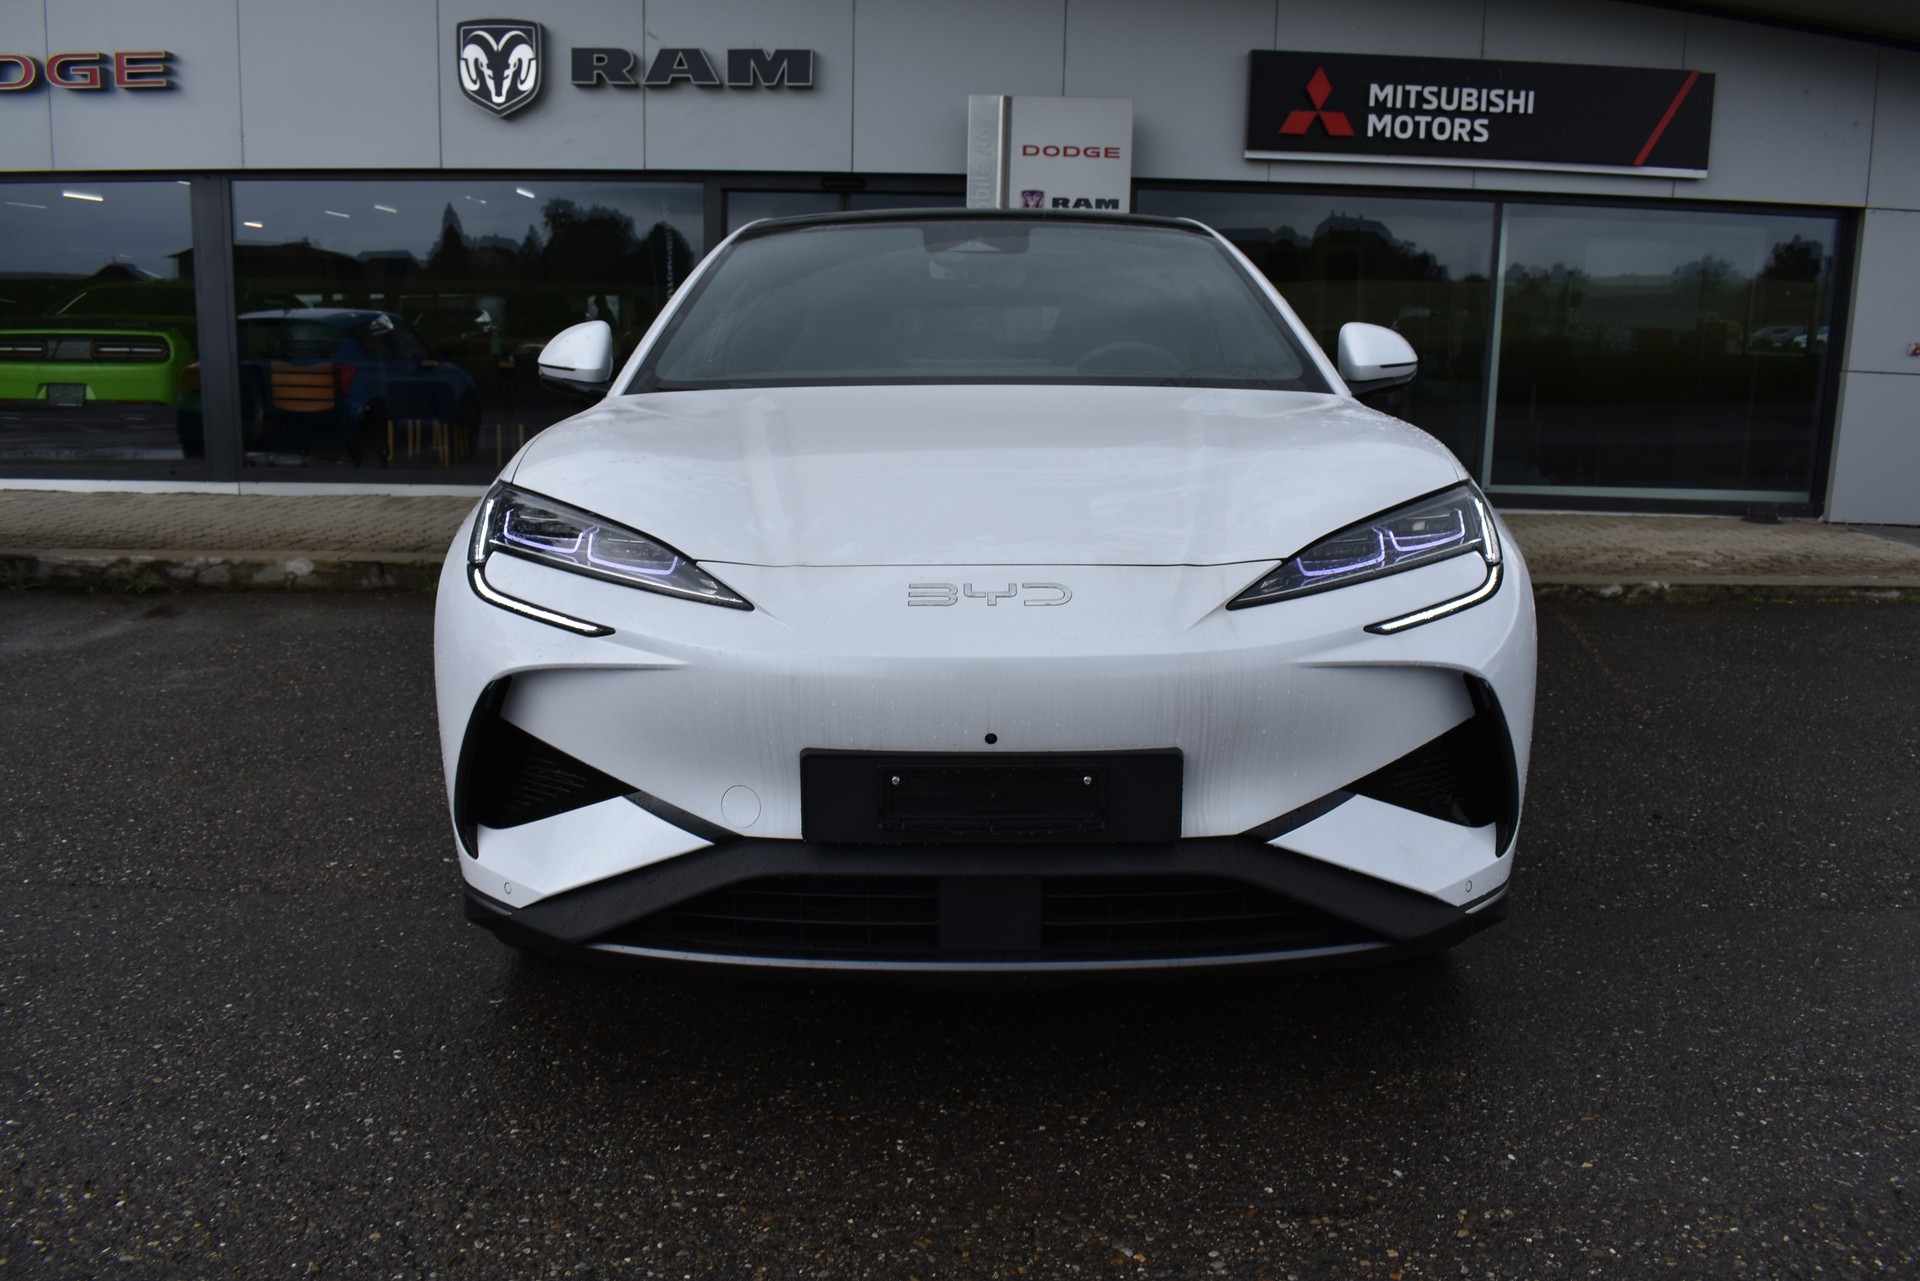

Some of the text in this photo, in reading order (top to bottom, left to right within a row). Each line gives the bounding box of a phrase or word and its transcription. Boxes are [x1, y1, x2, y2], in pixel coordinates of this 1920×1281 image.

[570, 47, 814, 86] RAM
[1368, 83, 1535, 114] MITSUBISHI
[1367, 113, 1490, 143] MOTORS
[1022, 145, 1121, 159] DODGE
[1051, 197, 1120, 210] RAM
[907, 582, 1073, 607] BYD
